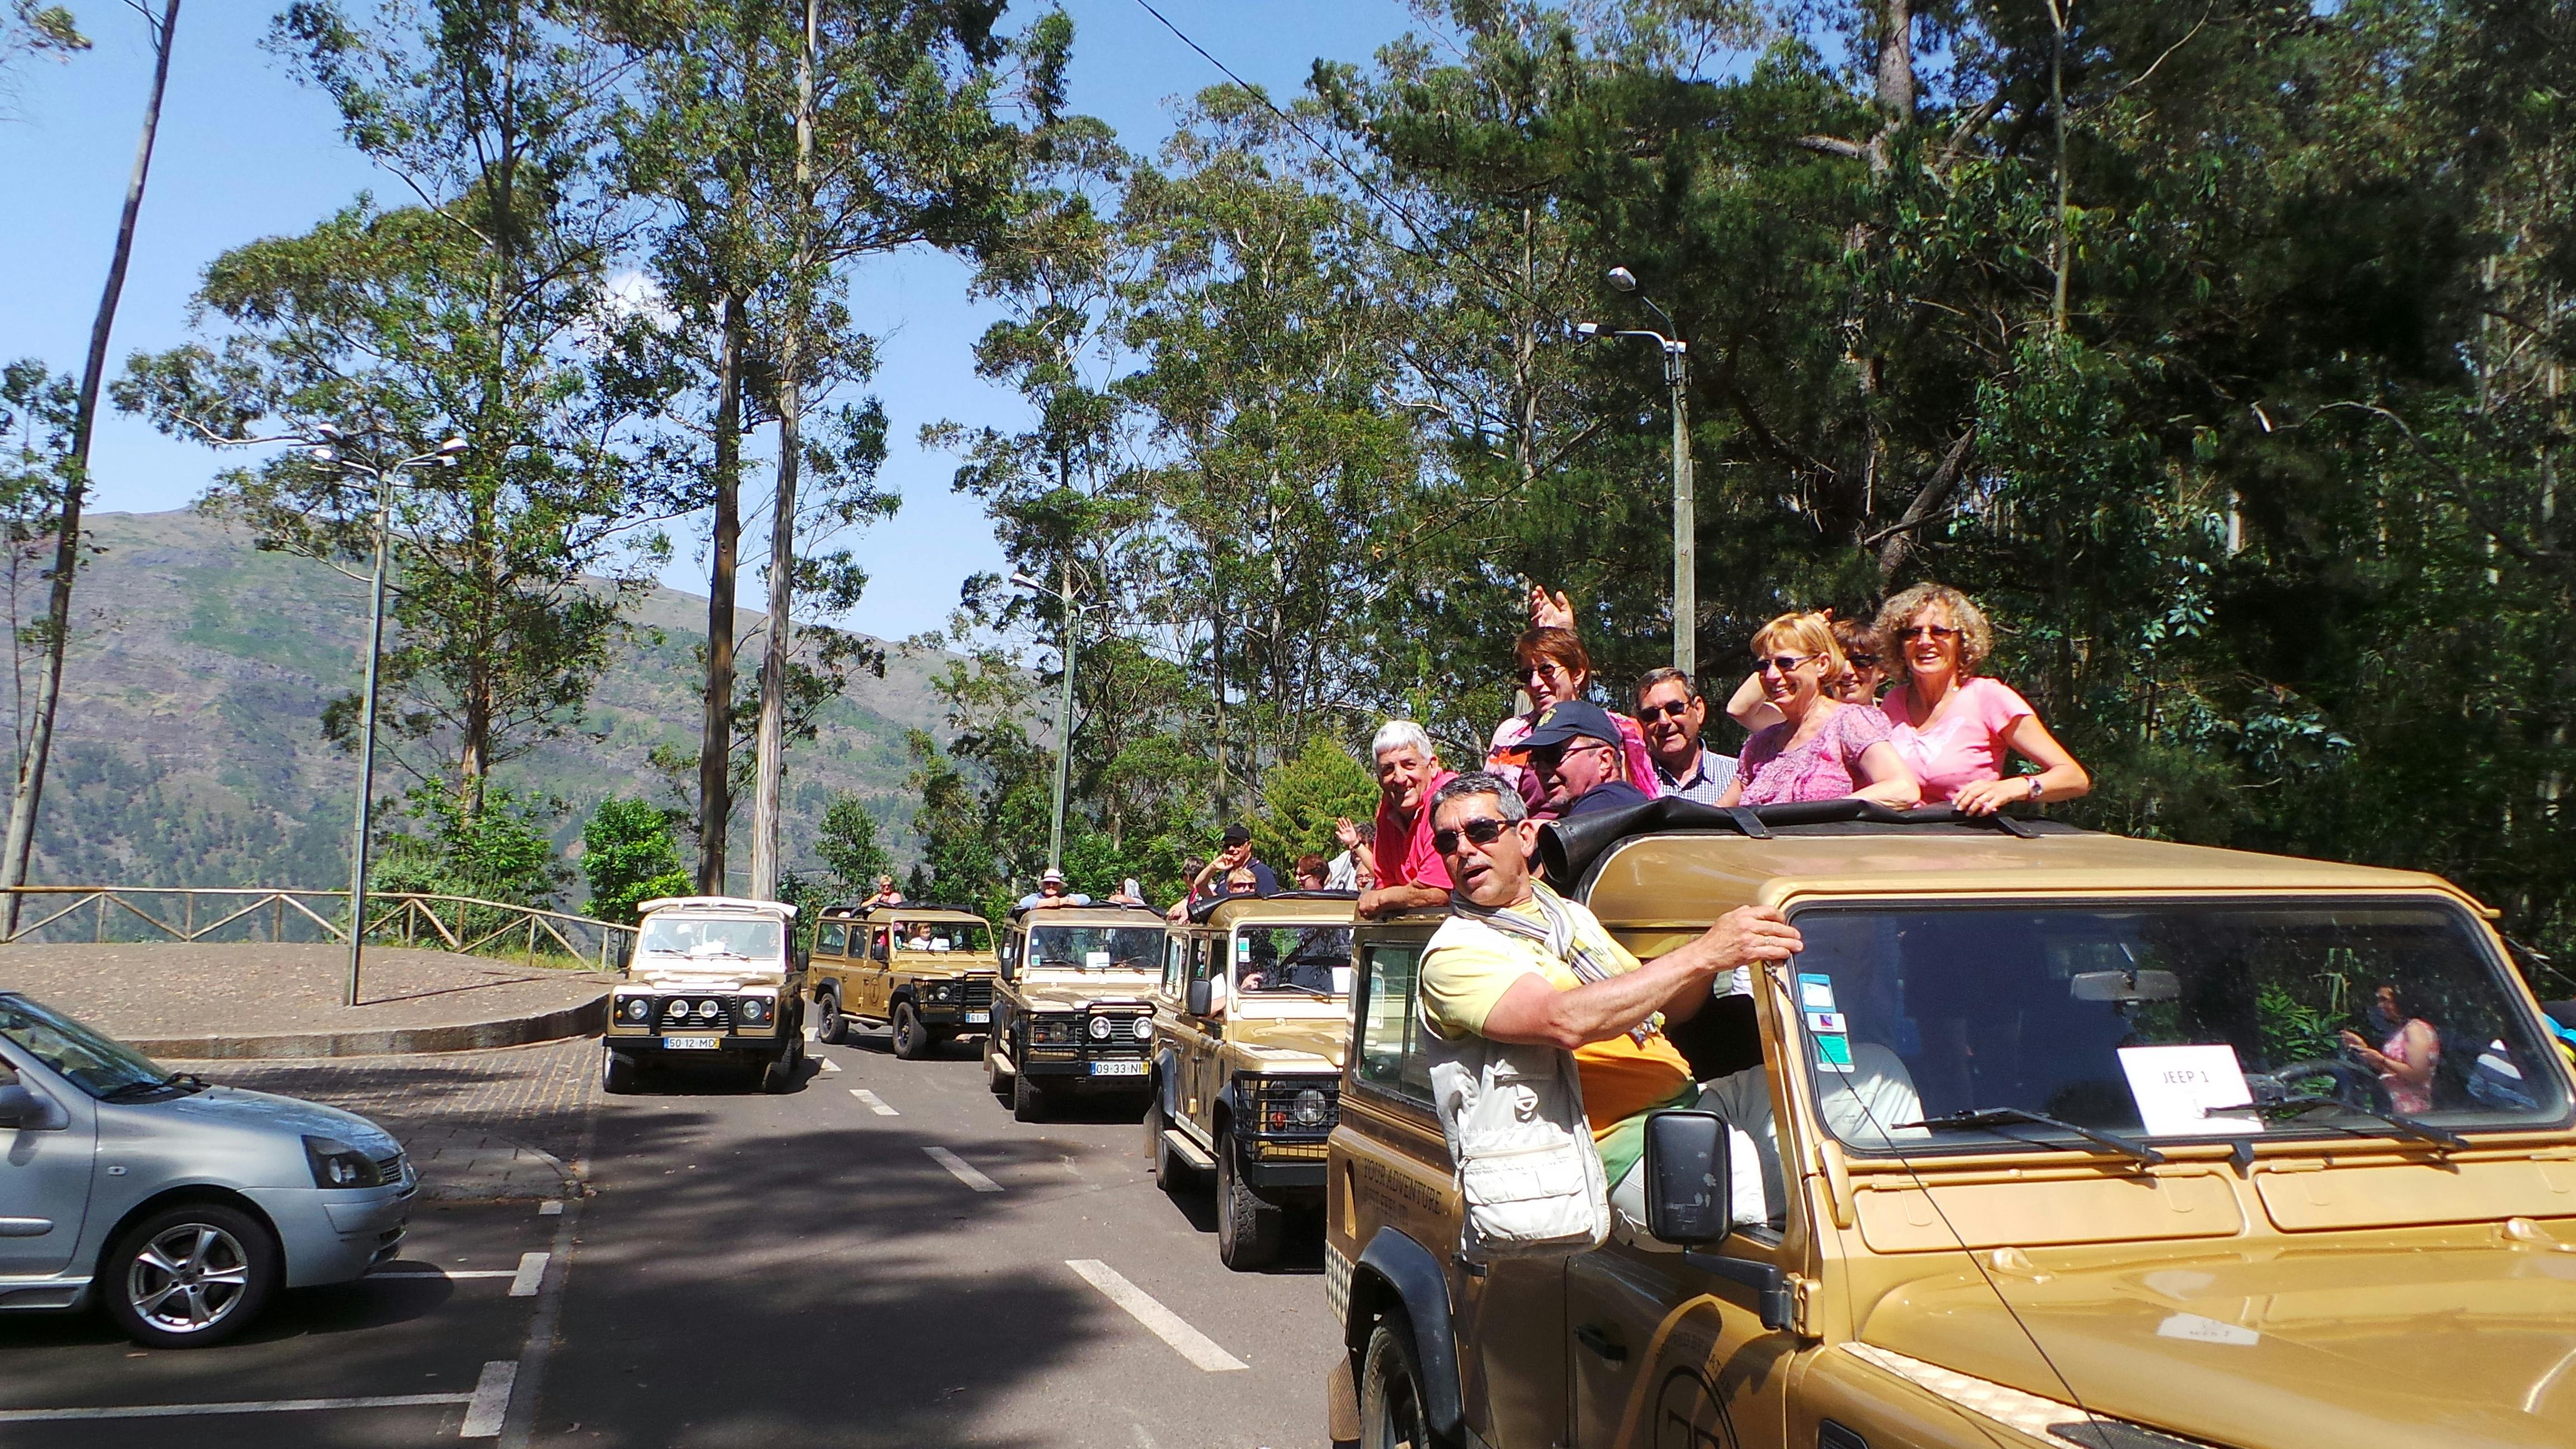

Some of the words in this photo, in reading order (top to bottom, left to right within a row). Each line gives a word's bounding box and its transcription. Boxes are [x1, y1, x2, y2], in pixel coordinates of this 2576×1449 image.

[1096, 1064, 1109, 1073] 09
[1114, 1064, 1126, 1073] 33
[2163, 1071, 2194, 1083] JEEP
[2201, 1071, 2209, 1082] 1
[1364, 1158, 1386, 1186] YOUR
[1386, 1168, 1442, 1215] ADVENTURE
